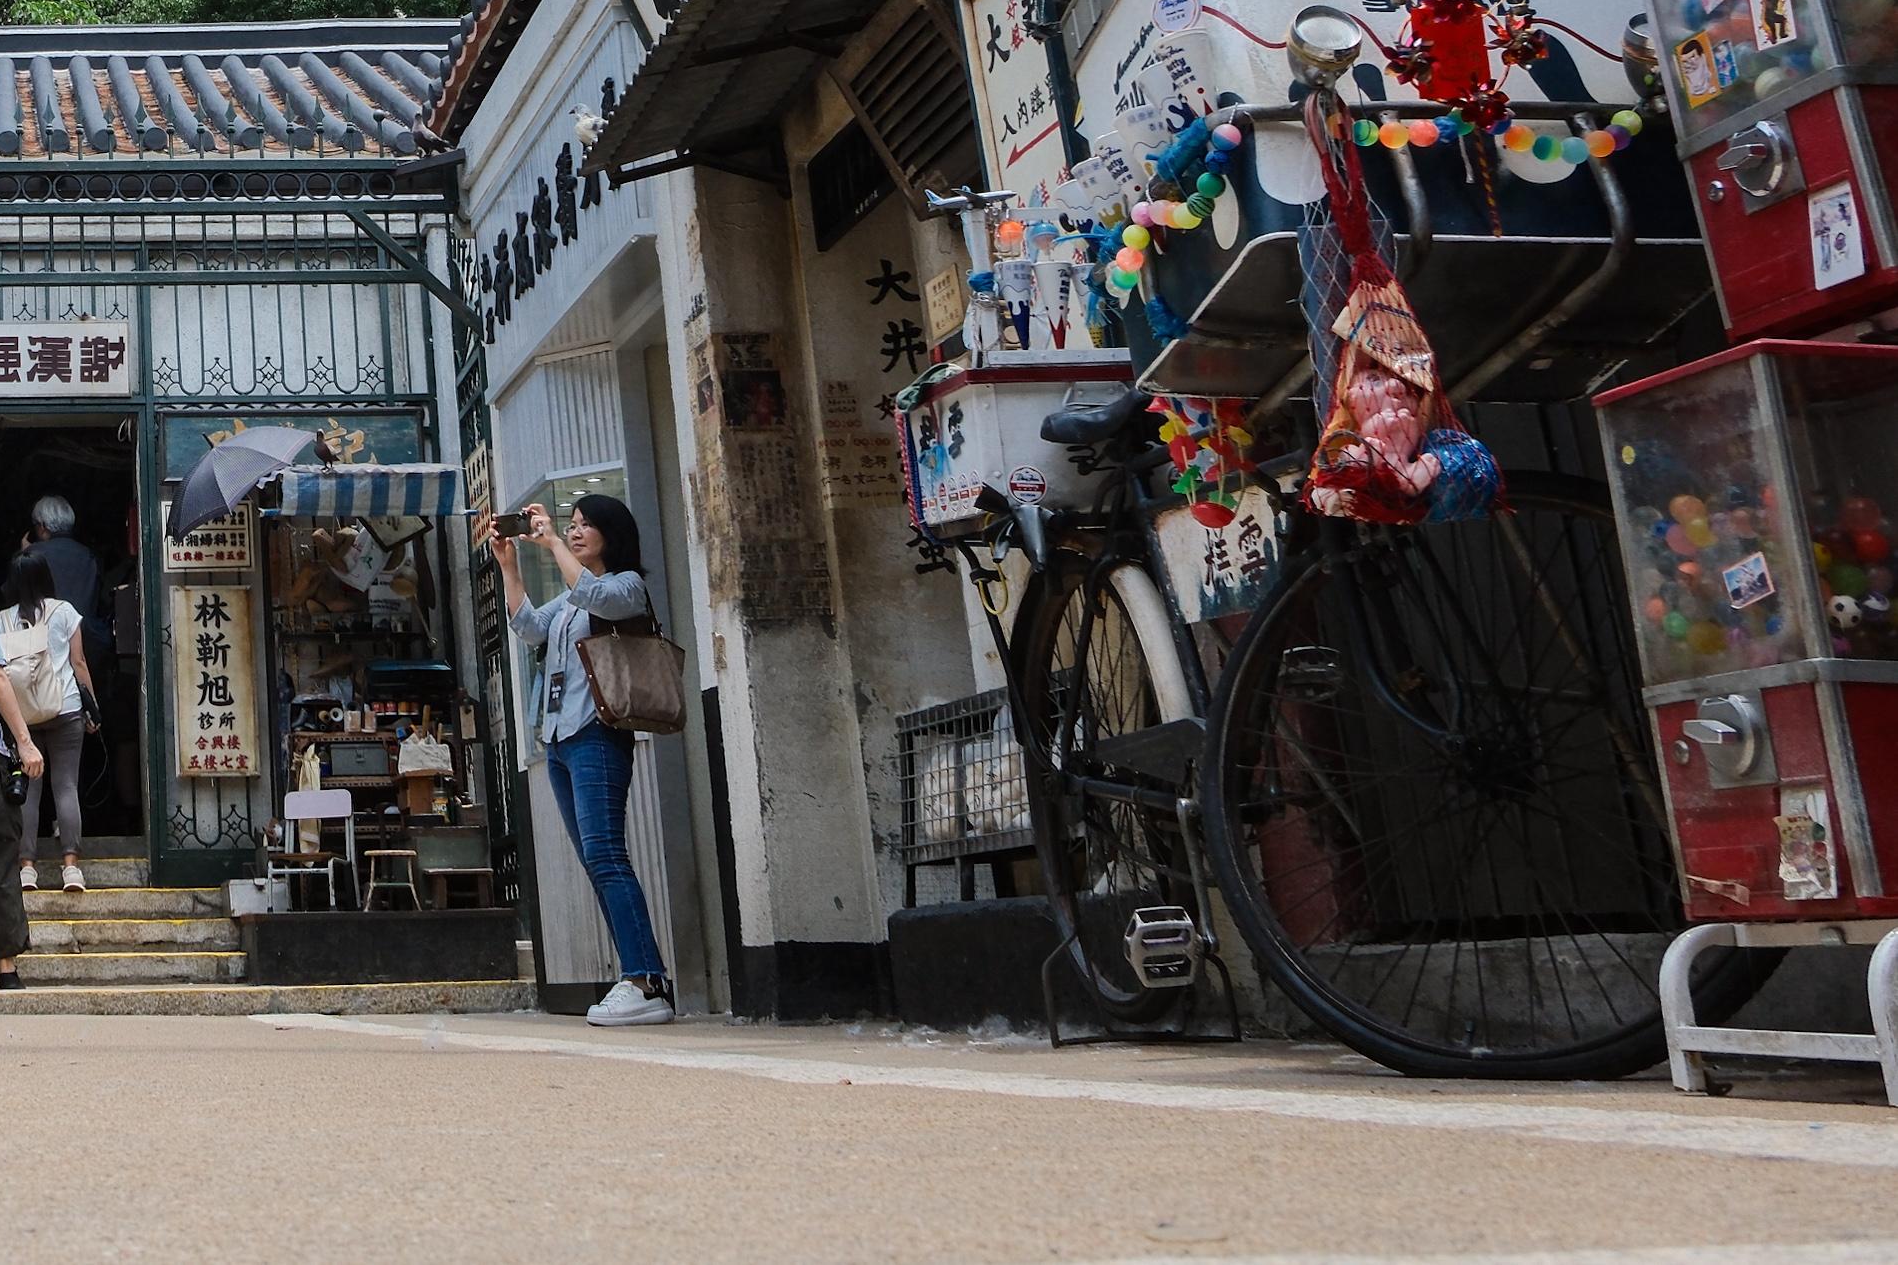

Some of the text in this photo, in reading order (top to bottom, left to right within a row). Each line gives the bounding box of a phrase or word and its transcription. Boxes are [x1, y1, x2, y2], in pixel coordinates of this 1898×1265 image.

[197, 711, 236, 731] 診所
[187, 754, 249, 771] 五樓七室
